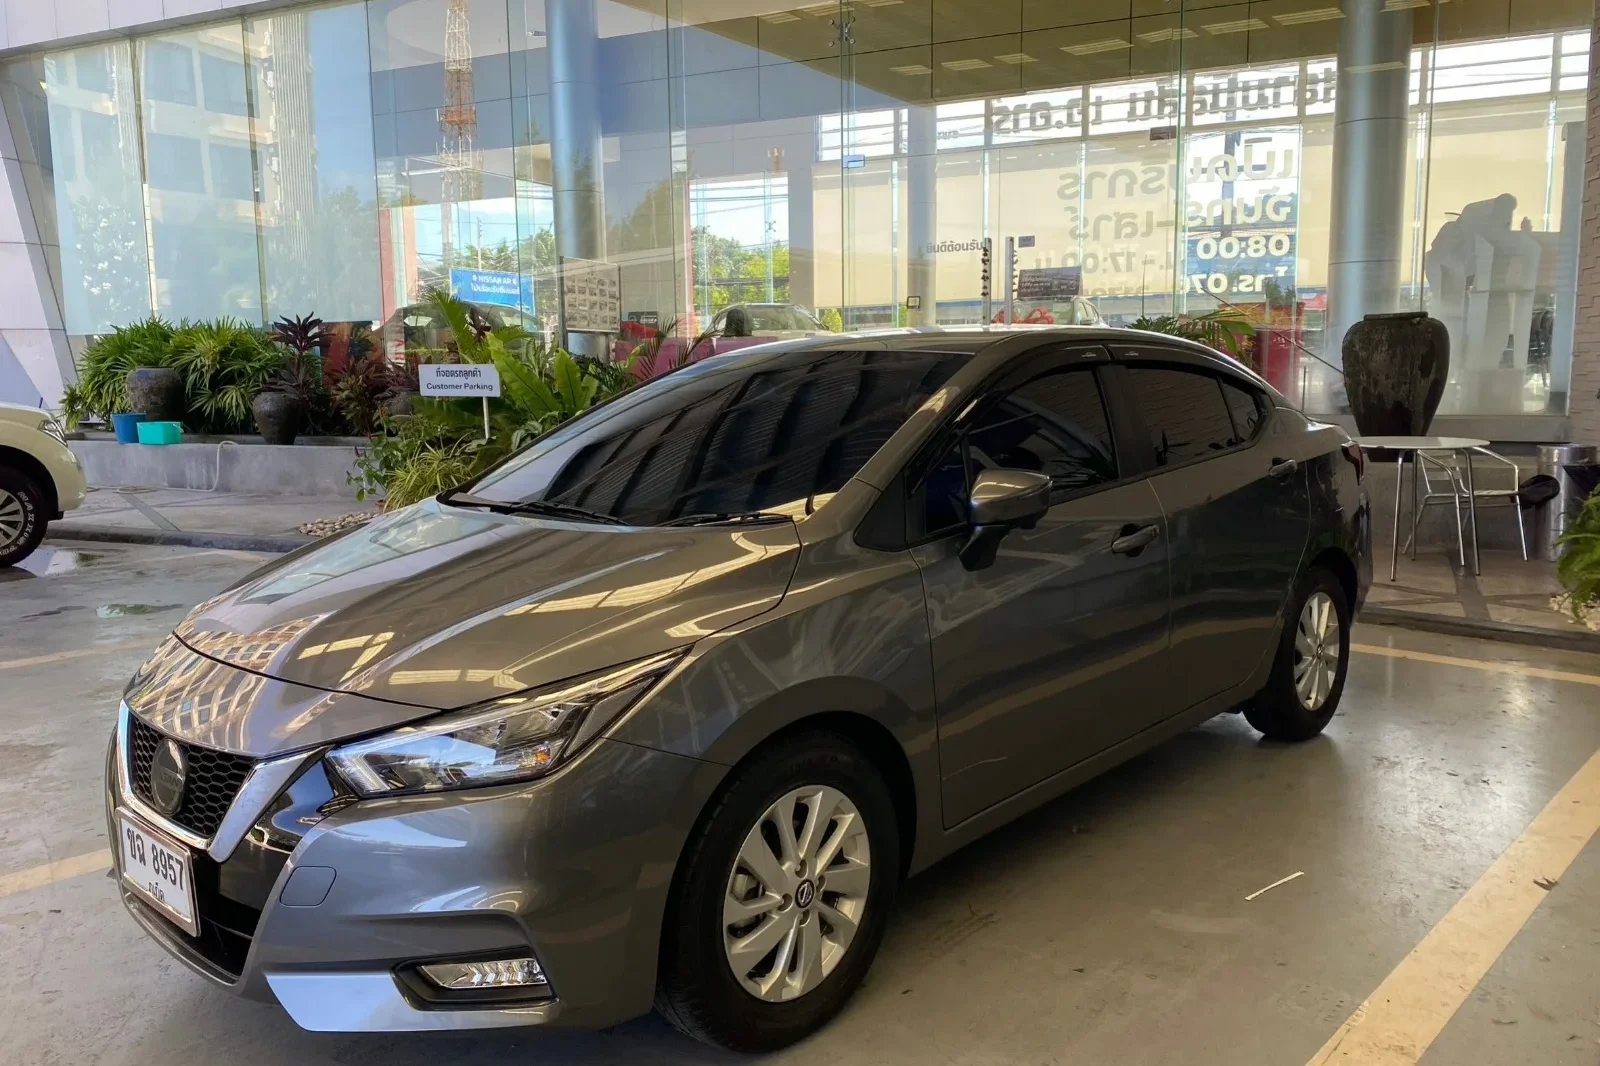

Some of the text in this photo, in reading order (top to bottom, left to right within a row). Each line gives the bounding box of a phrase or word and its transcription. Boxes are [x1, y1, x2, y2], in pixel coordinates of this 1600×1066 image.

[436, 366, 482, 379] ที่จอดรถลูกค้า
[464, 383, 493, 391] Parking
[151, 843, 184, 890] 8957
